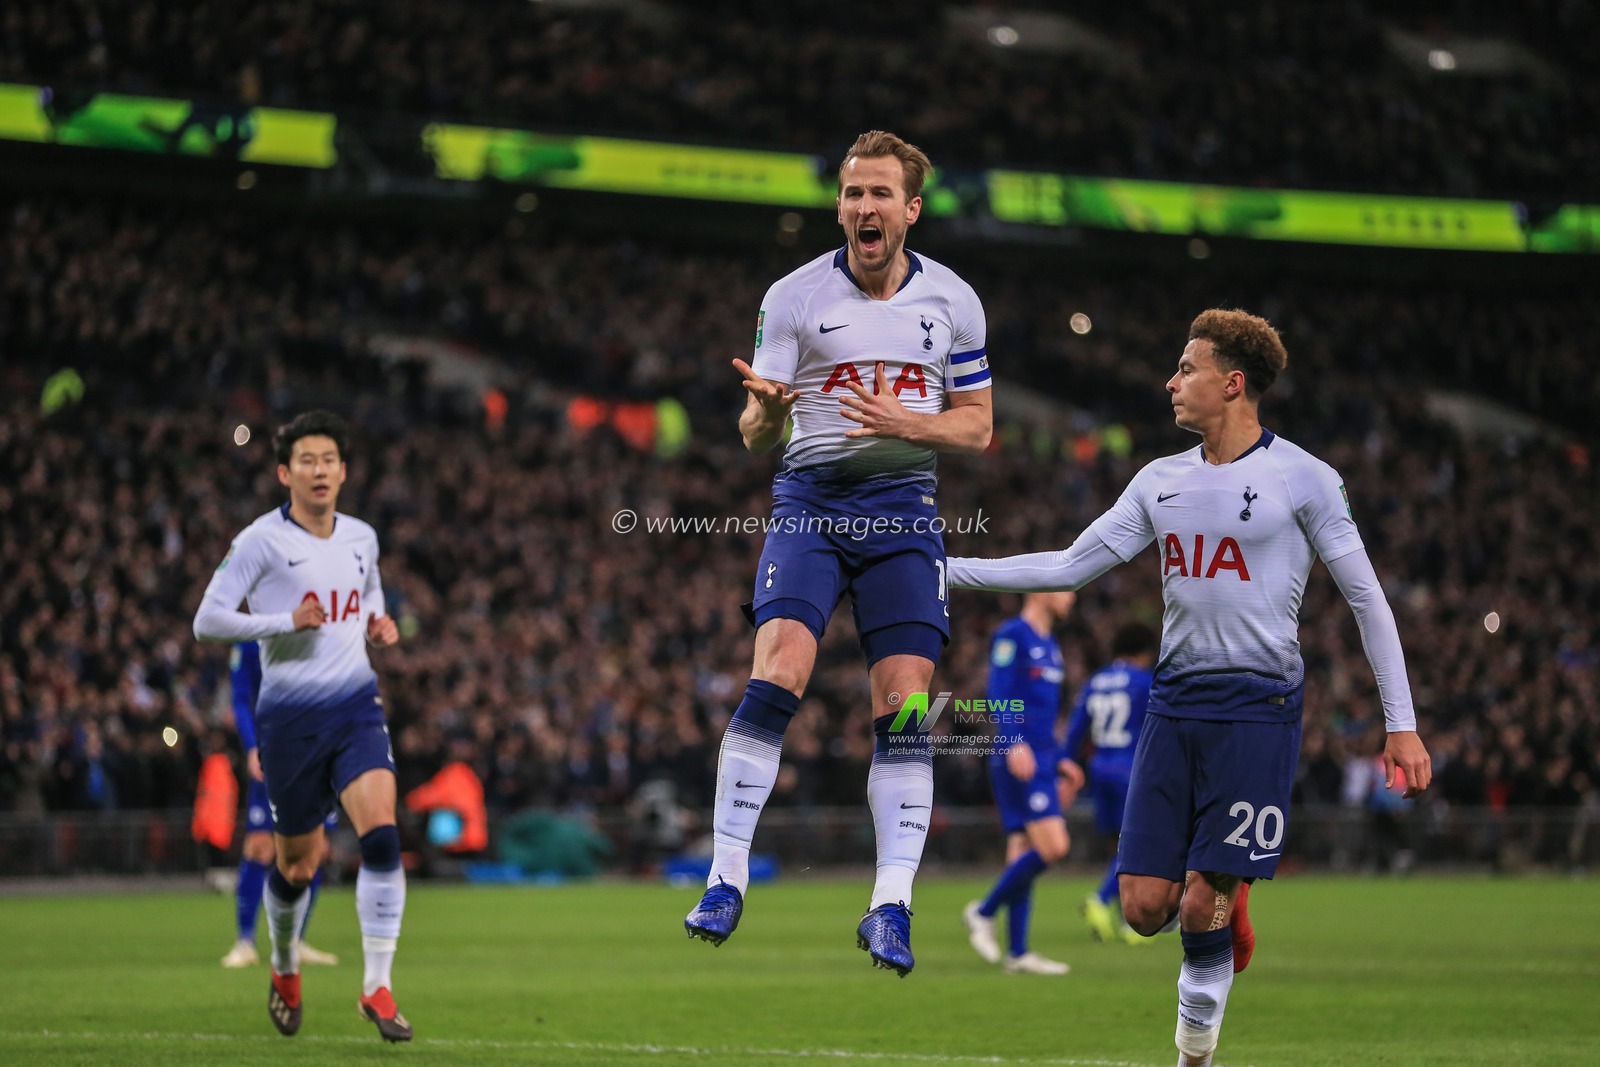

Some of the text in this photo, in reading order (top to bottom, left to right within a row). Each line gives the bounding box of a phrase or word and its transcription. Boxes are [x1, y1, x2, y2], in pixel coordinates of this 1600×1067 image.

[820, 360, 928, 399] AIA
[1164, 533, 1251, 582] AIA
[733, 800, 761, 811] SPURS
[899, 820, 927, 832] SPURS
[1223, 801, 1285, 850] 20
